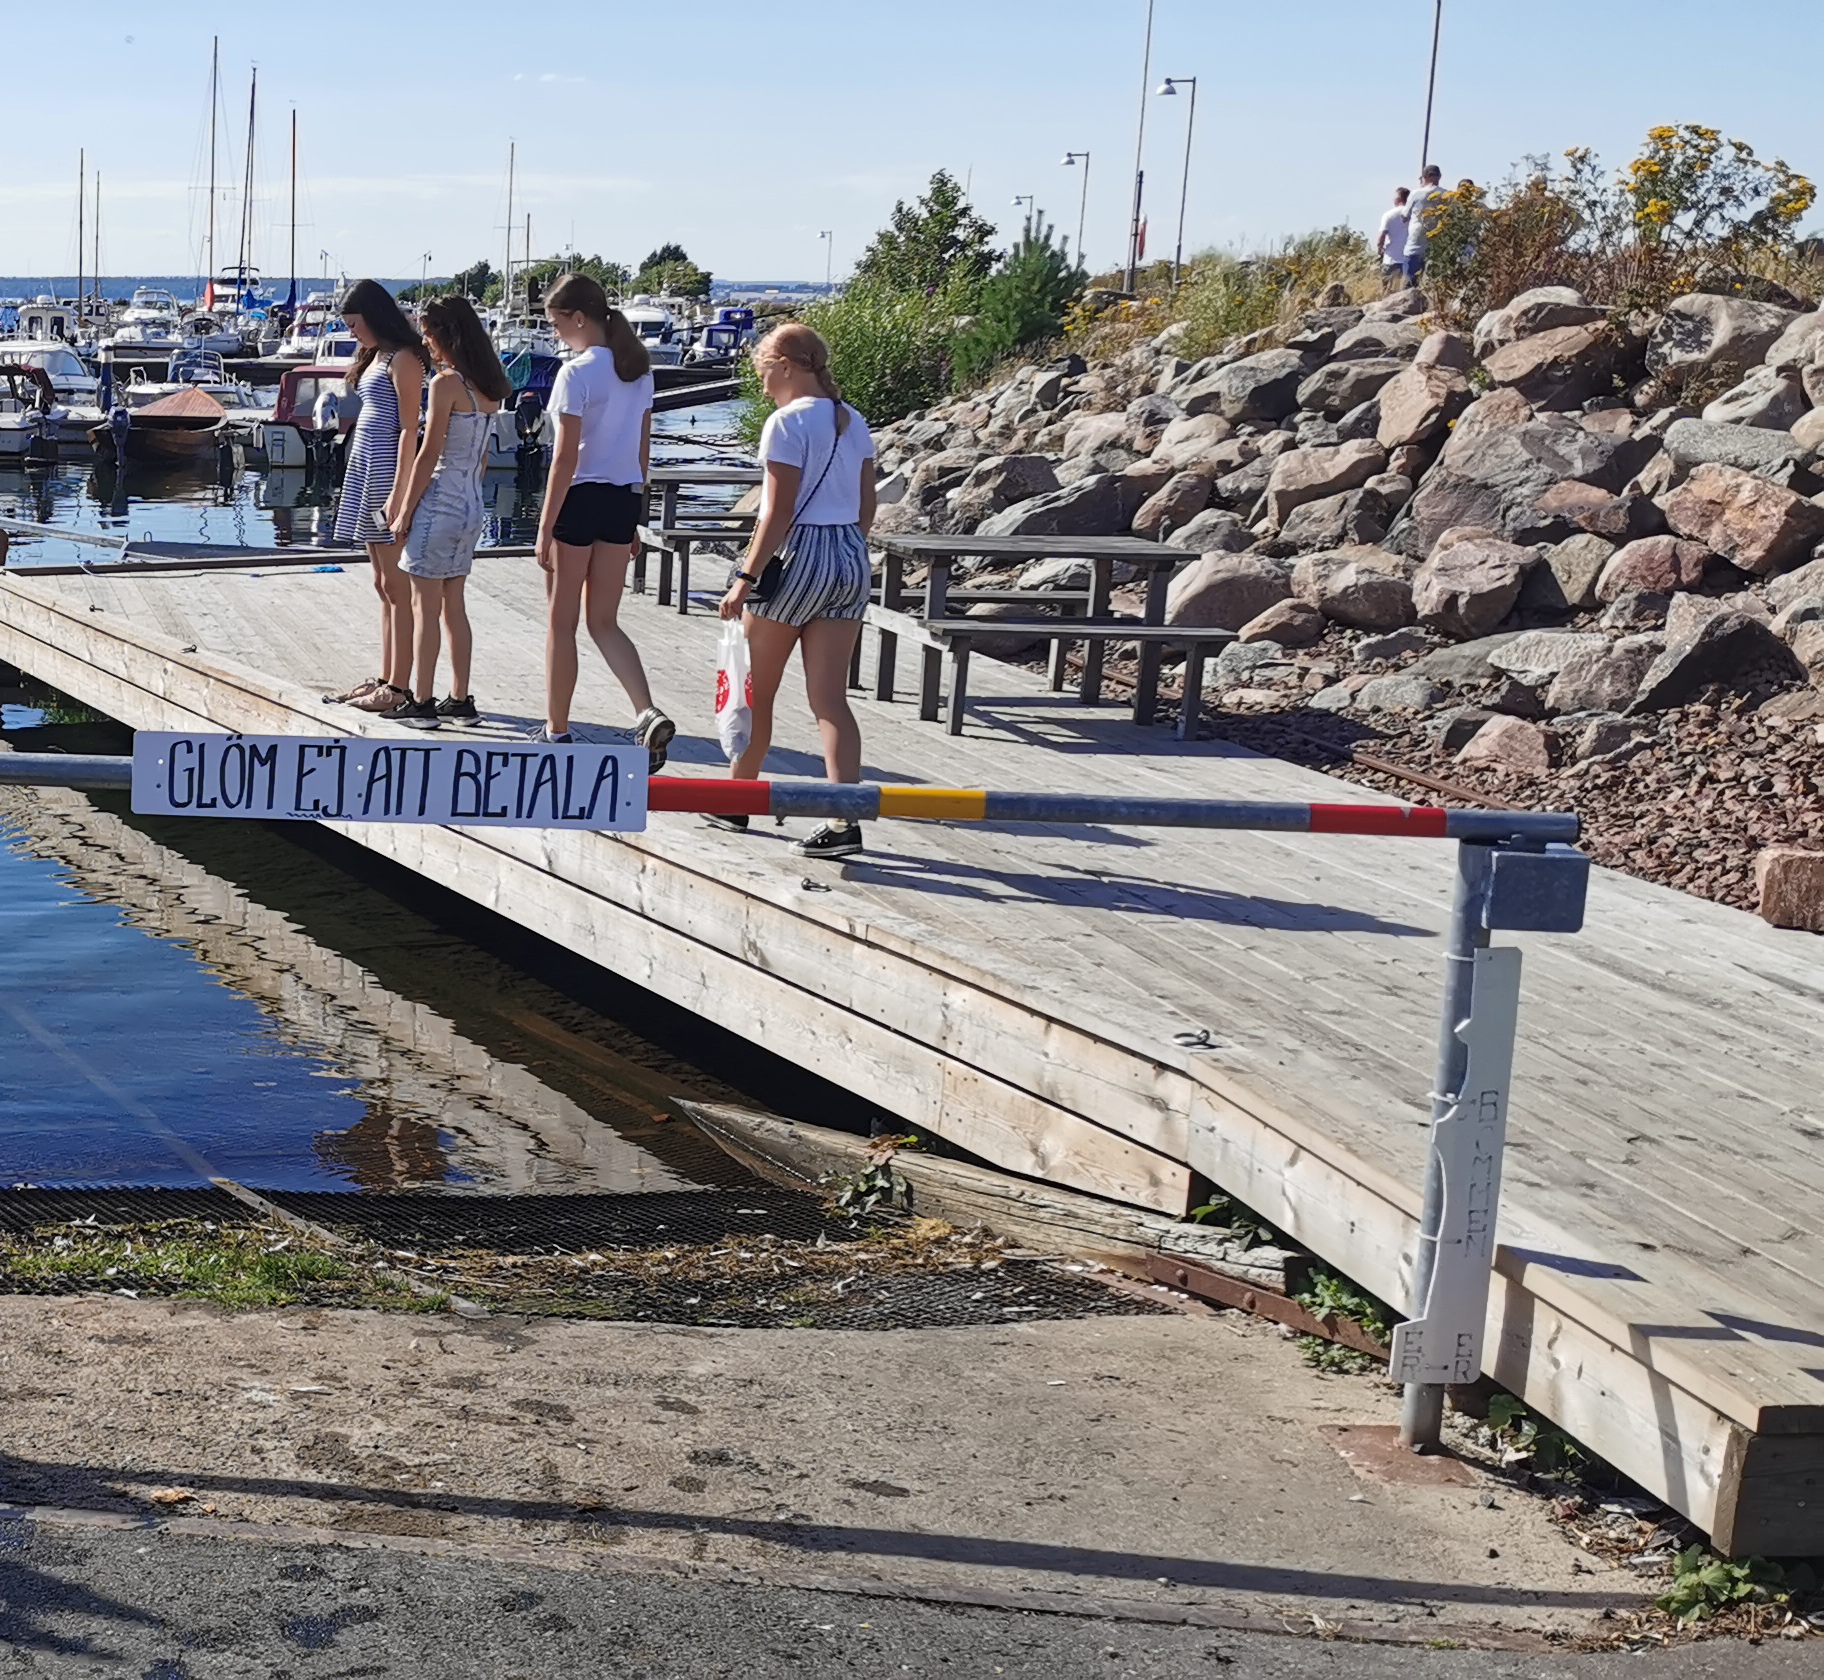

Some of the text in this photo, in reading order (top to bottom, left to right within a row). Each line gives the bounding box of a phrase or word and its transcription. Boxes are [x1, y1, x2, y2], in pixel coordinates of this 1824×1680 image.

[167, 734, 619, 823] GLÖM EJ ATT BETALA
